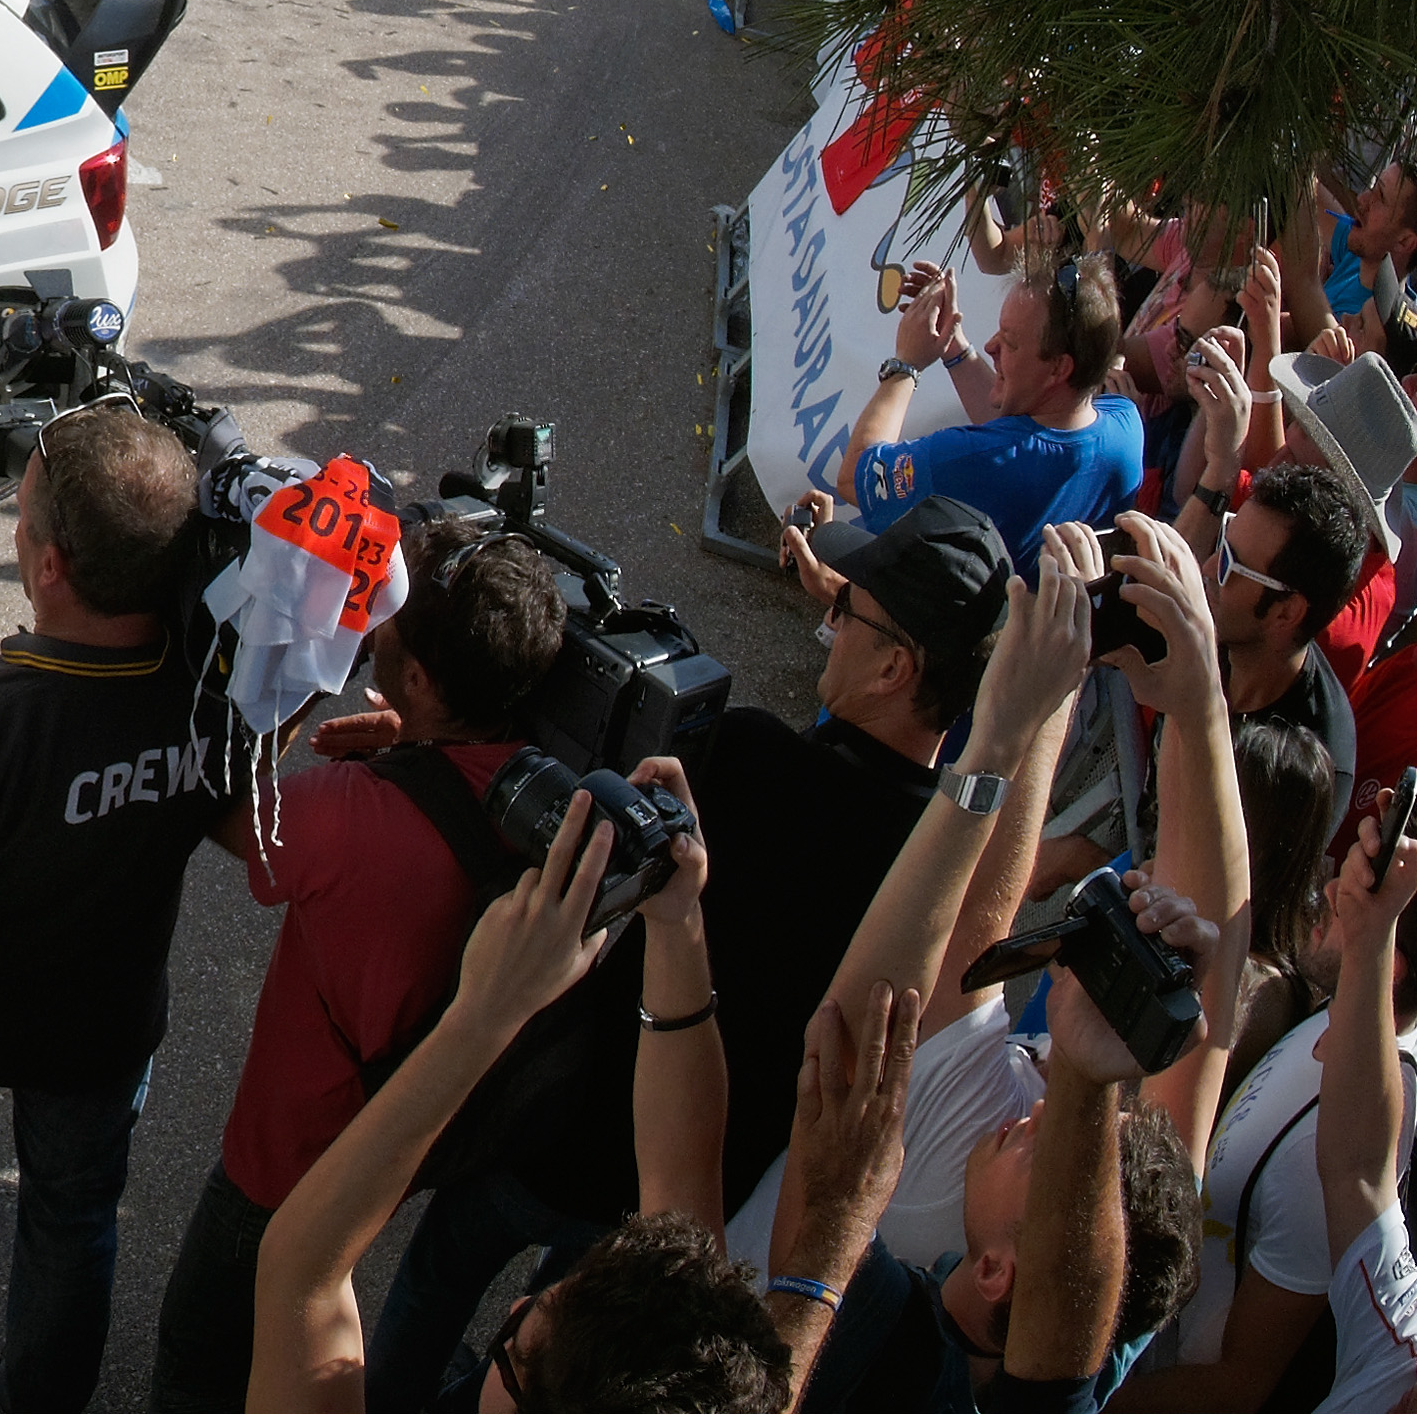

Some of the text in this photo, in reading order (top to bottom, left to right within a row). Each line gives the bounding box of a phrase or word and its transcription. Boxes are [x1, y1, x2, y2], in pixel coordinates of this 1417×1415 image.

[93, 69, 129, 87] OMP
[281, 484, 365, 552] 201
[63, 736, 212, 826] CREW
